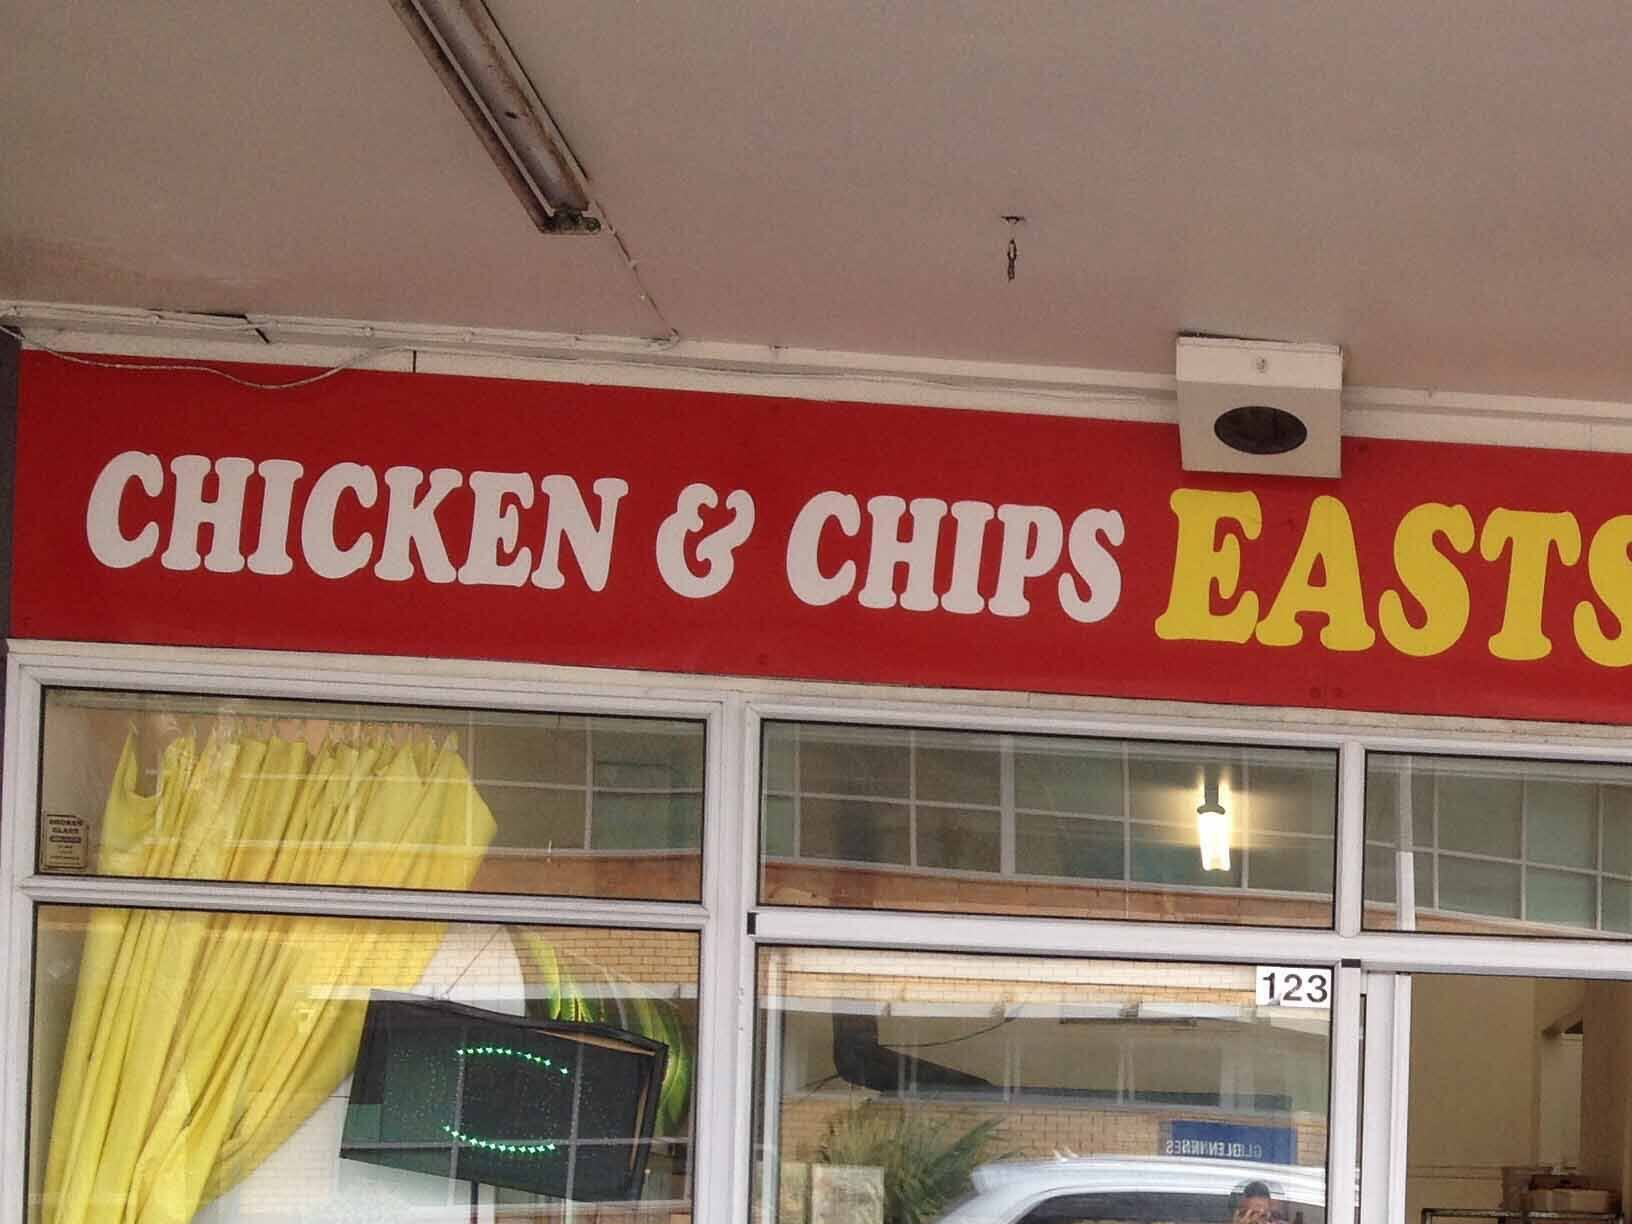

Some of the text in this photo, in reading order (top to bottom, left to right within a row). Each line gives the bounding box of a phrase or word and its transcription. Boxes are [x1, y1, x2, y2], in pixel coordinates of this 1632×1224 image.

[85, 450, 1125, 623] CHICKEN & CHIPS
[1262, 972, 1328, 1003] 123
